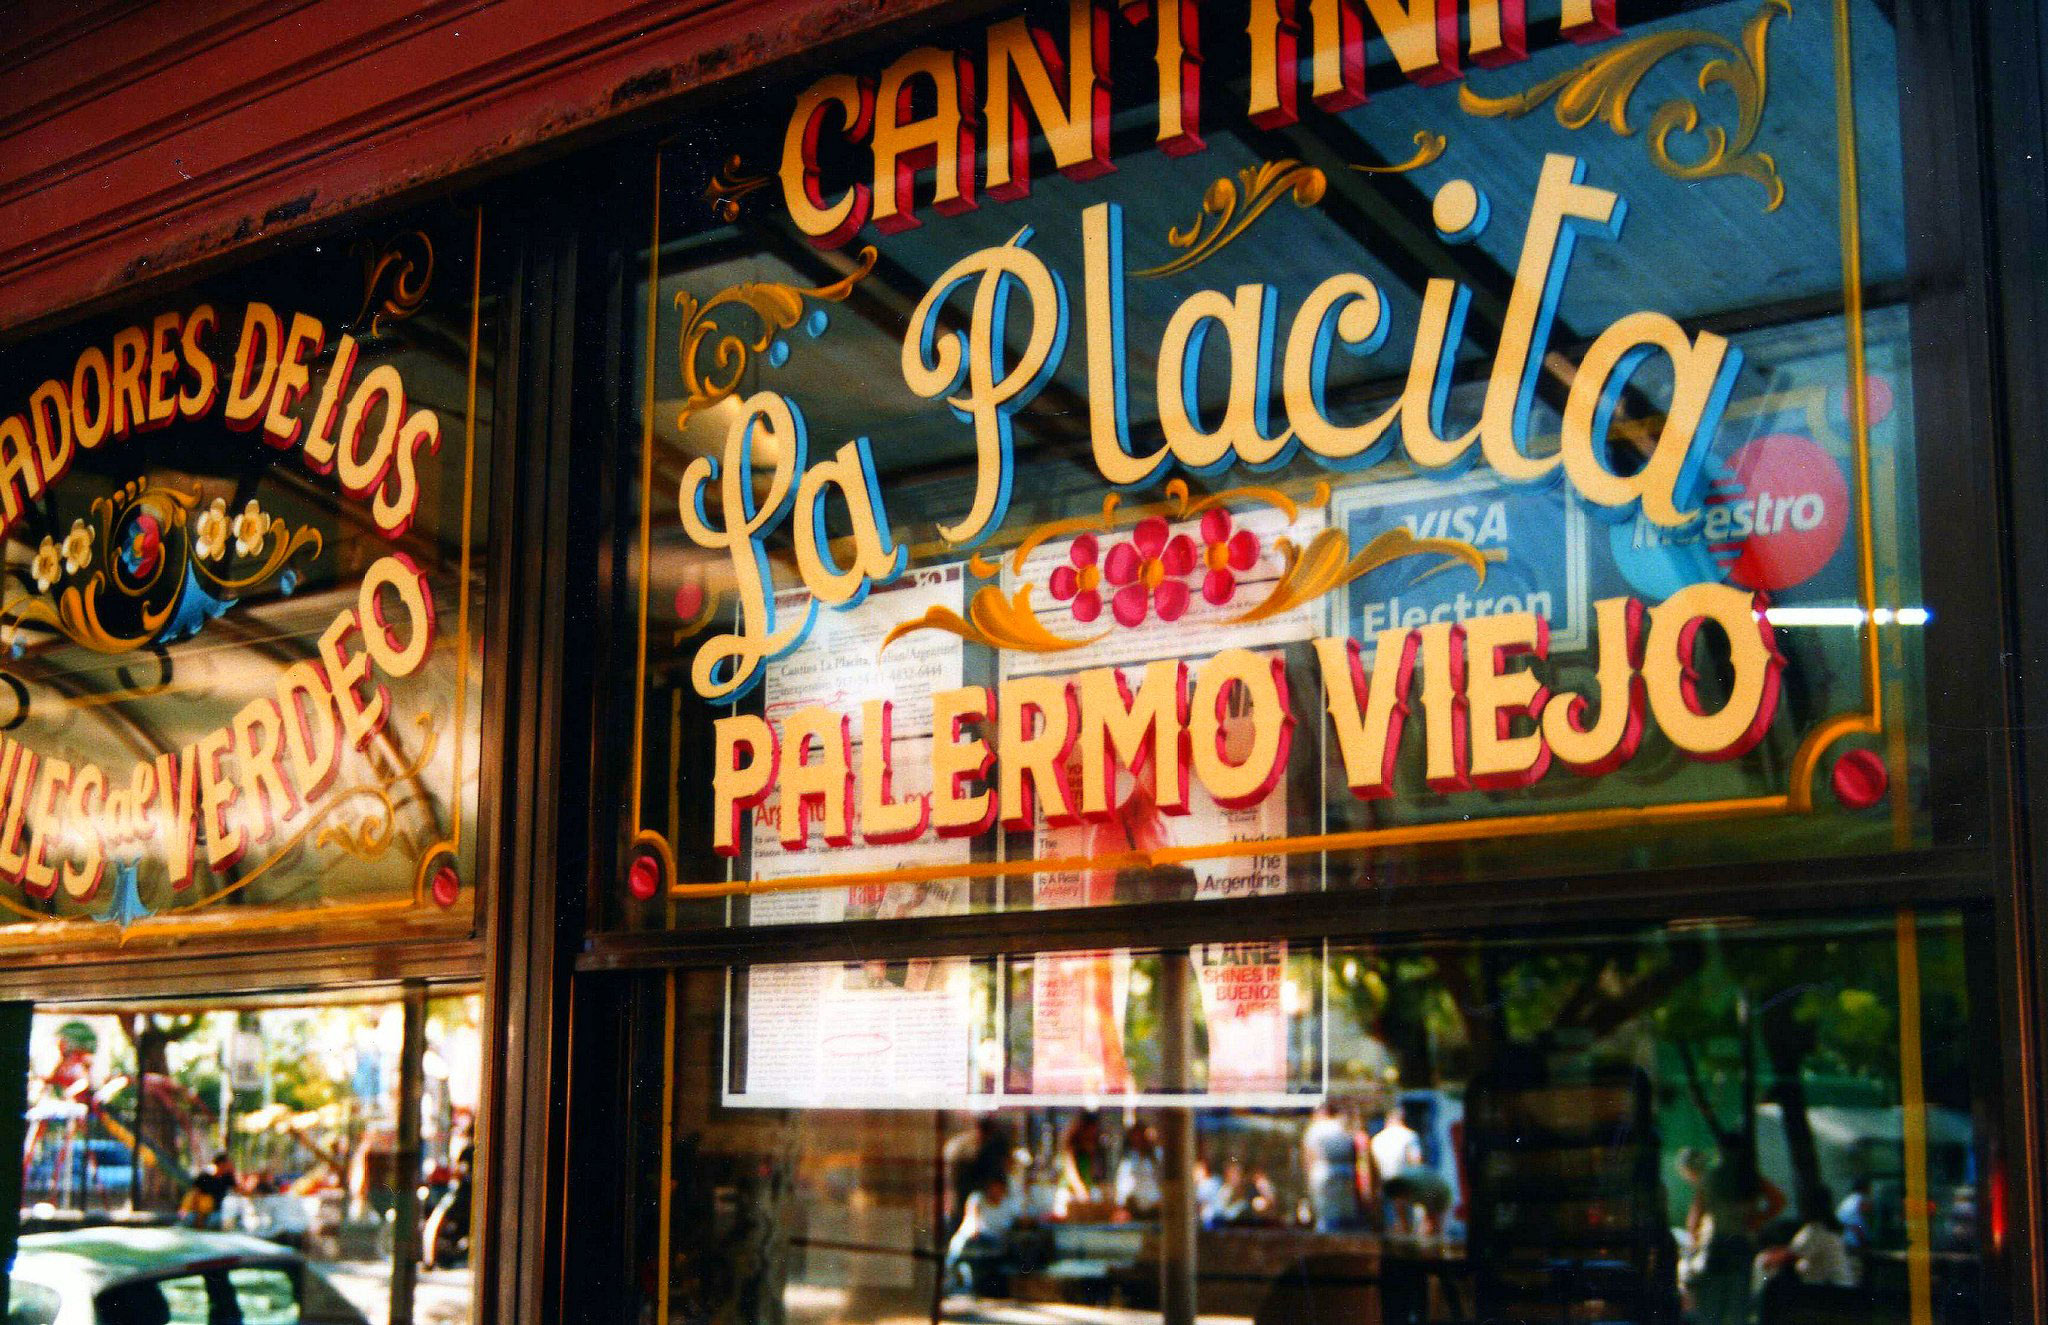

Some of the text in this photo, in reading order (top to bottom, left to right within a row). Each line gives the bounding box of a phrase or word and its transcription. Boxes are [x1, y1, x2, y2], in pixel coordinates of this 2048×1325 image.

[0, 301, 441, 539] ADORES DE LOS
[680, 151, 1745, 706] La Placita
[1401, 502, 1509, 546] VISA
[1631, 491, 1826, 551] Mestro
[156, 552, 436, 891] VERDEO
[712, 582, 1787, 856] PALERMO VIEJO
[1363, 590, 1552, 643] Electron
